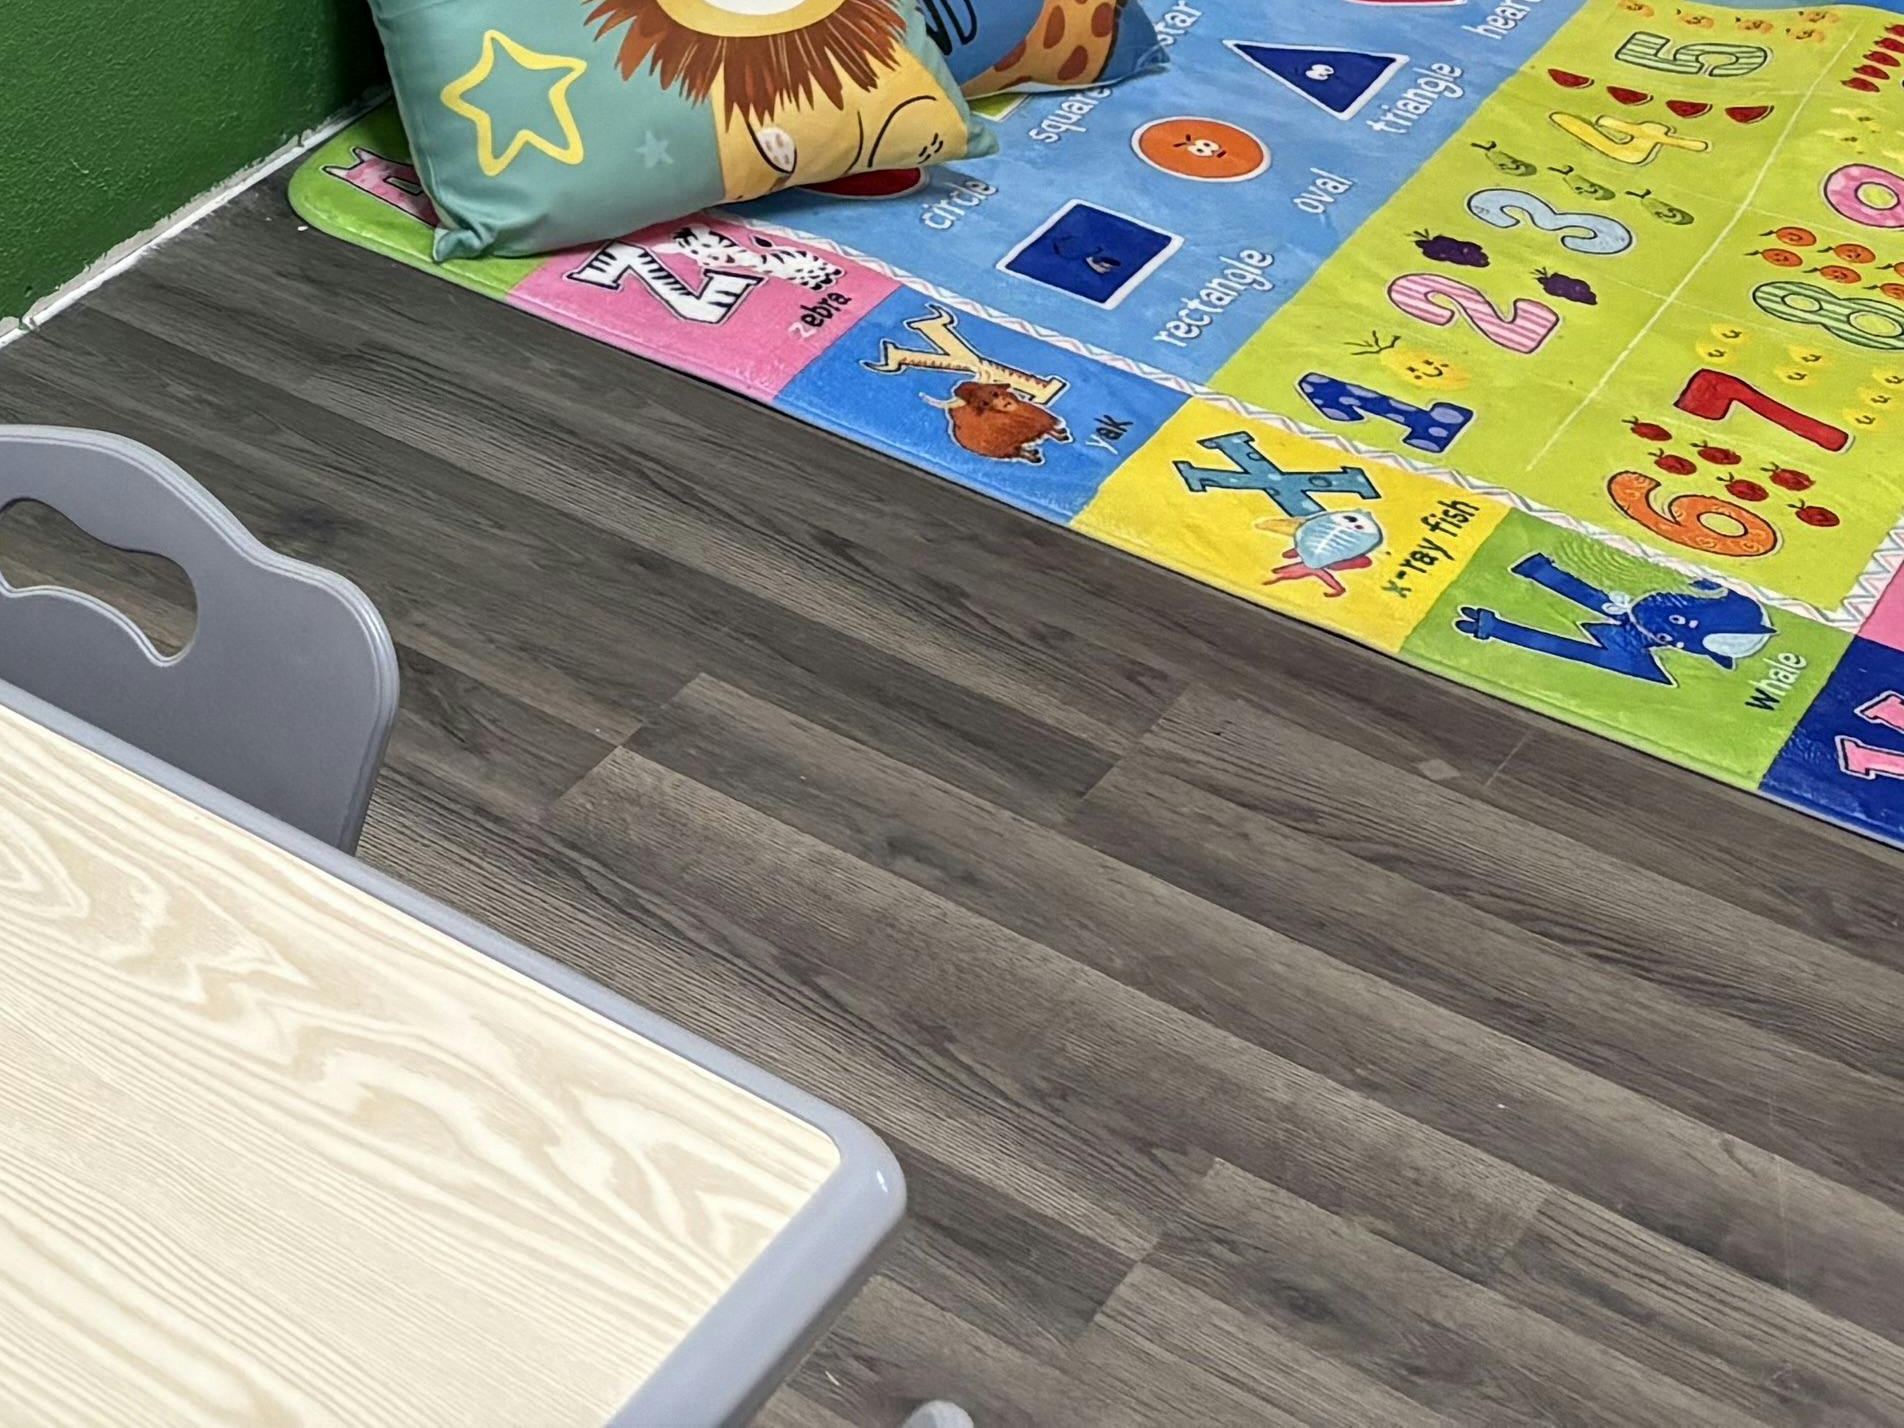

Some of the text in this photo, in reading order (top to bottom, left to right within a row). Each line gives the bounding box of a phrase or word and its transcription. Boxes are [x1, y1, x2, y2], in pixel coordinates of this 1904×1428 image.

[1613, 29, 1772, 78] 5
[1029, 86, 1111, 143] square
[1367, 59, 1464, 134] triangle
[1548, 109, 1711, 165] 4
[919, 177, 999, 231] circle
[1292, 170, 1353, 217] oval
[1465, 187, 1635, 256] 3
[563, 238, 765, 325] Z
[788, 289, 852, 339] zebra
[1153, 248, 1275, 348] rectangle
[1387, 270, 1560, 353] 2
[1749, 279, 1904, 351] 8
[1084, 412, 1135, 453] yak
[1295, 371, 1475, 454] 1
[1673, 368, 1853, 454] 7
[1173, 429, 1381, 519] X
[1384, 497, 1482, 599] x-ray fish
[1604, 469, 1780, 557] 6
[1744, 651, 1808, 711] whale
